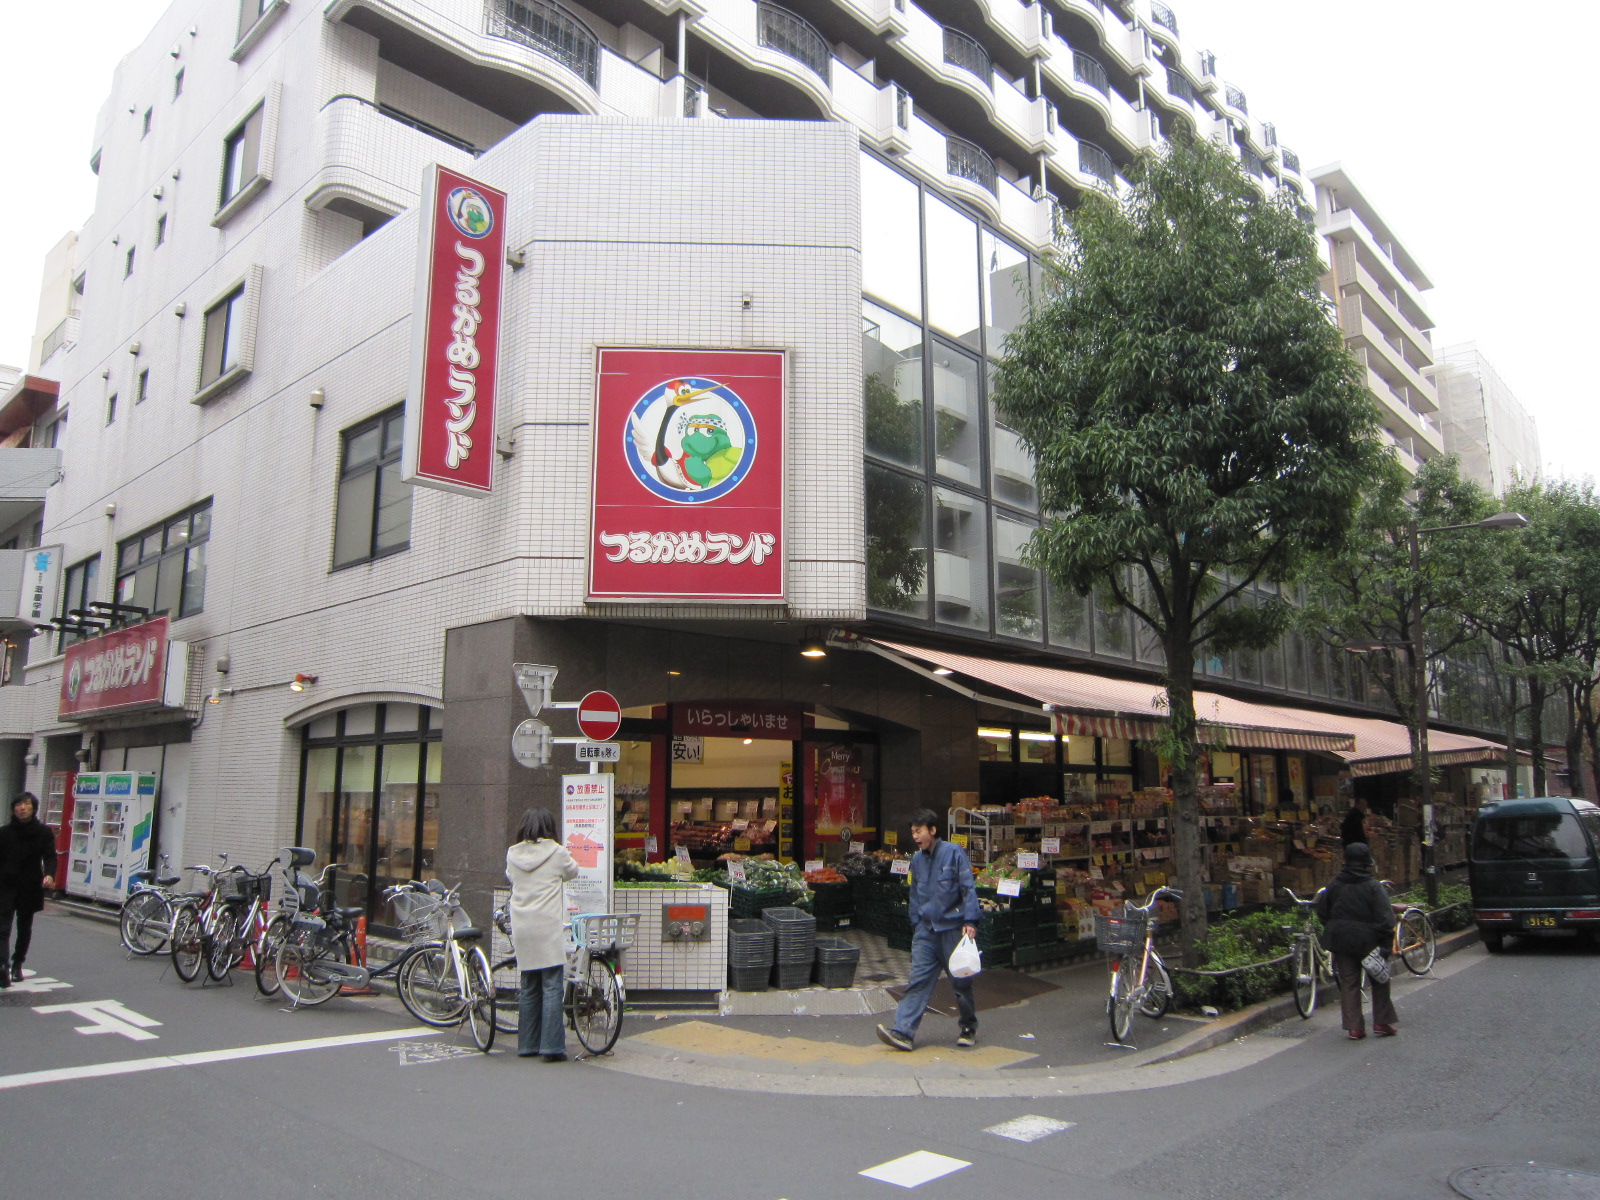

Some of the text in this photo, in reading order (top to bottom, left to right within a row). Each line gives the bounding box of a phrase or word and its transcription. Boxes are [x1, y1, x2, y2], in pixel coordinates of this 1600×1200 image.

[445, 241, 485, 470] つるかめランド
[599, 531, 776, 566] つるかめランド
[84, 636, 158, 694] つるかめランド
[687, 708, 789, 729] いらっしゃいませ
[580, 747, 616, 758] 自転車を除く
[673, 742, 700, 760] 安い!
[831, 751, 850, 762] Merry
[576, 783, 605, 795] 放置禁止
[733, 870, 744, 878] 98
